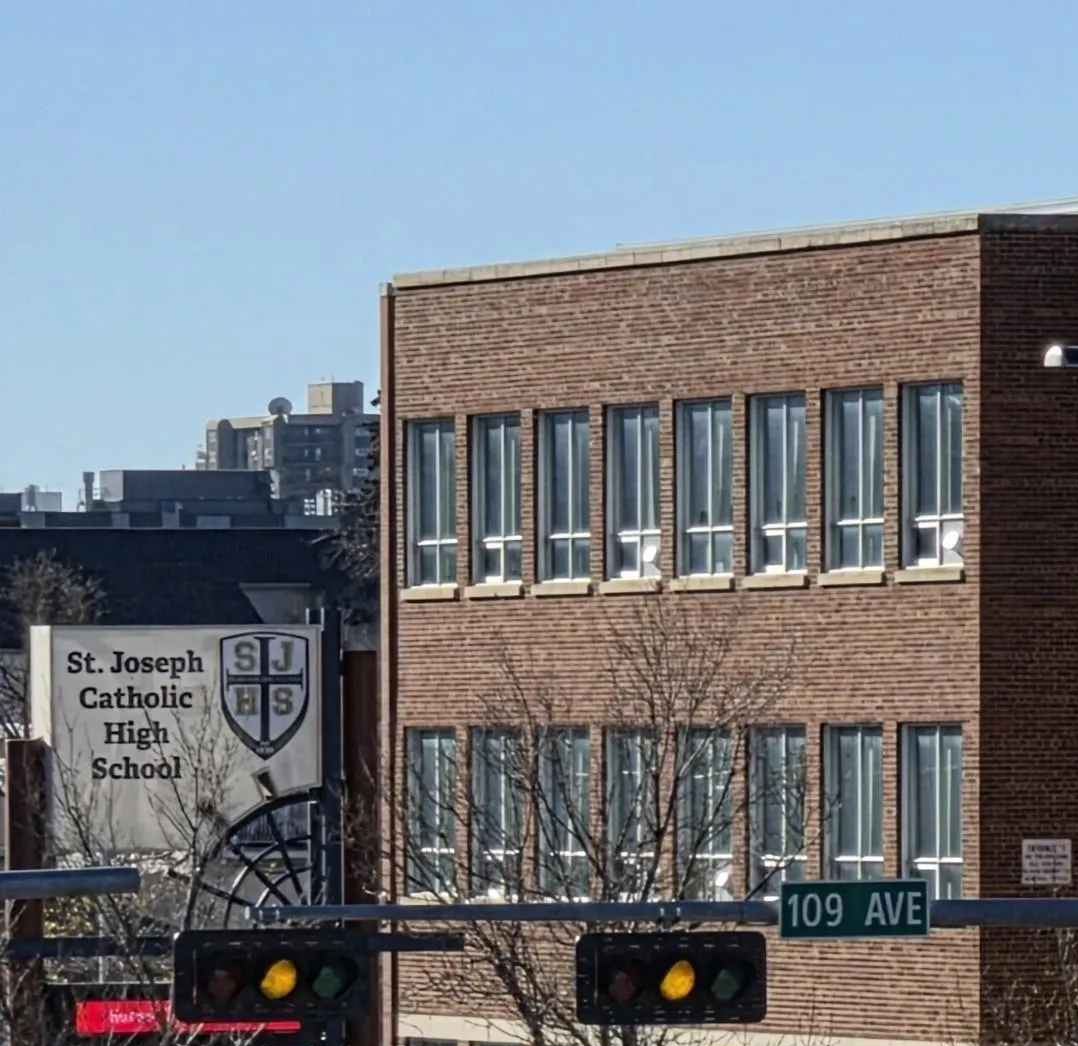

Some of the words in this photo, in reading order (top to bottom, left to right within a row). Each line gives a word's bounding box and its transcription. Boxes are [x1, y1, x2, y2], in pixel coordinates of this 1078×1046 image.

[67, 651, 104, 674] St.
[110, 649, 204, 679] Joseph
[79, 684, 193, 709] Catholic
[103, 720, 170, 751] High
[91, 756, 182, 779] School
[787, 892, 843, 928] 109
[864, 891, 923, 926] AVE
